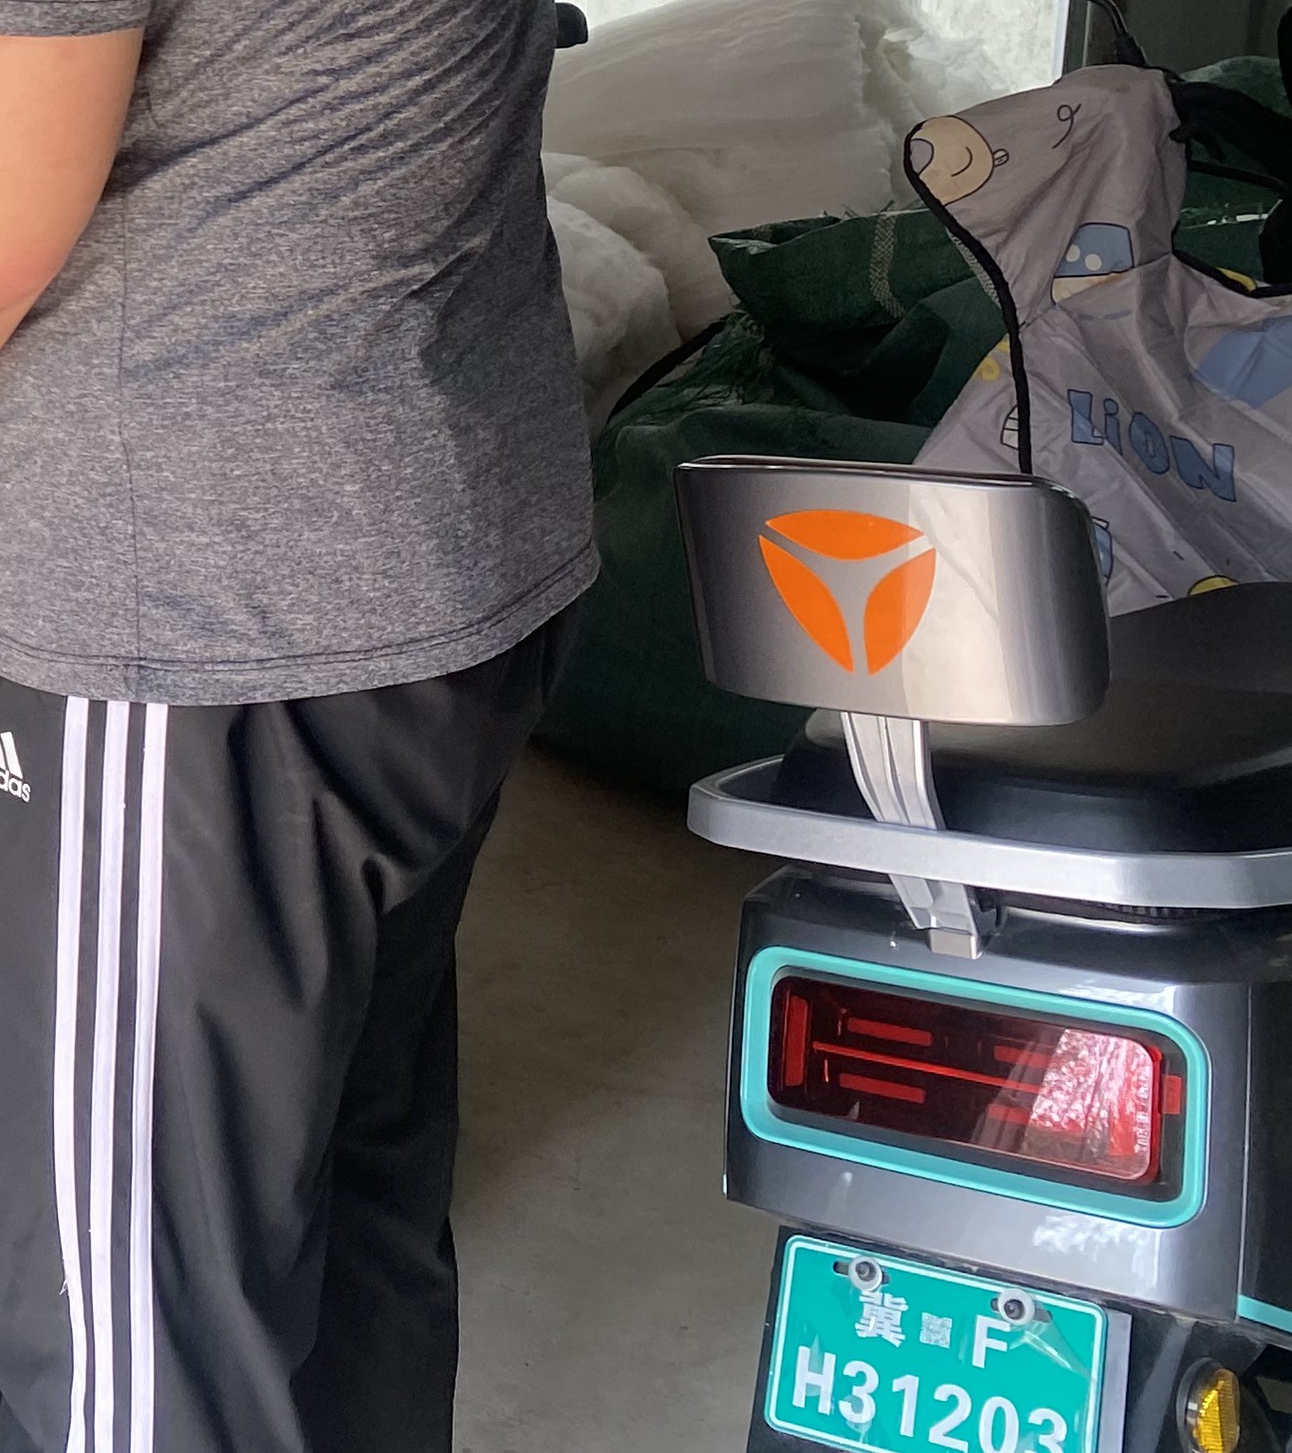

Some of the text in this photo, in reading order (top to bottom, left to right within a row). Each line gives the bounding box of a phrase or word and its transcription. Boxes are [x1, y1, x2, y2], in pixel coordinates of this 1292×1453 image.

[855, 1290, 1011, 1368] 冀 F
[792, 1346, 1068, 1453] H31203
